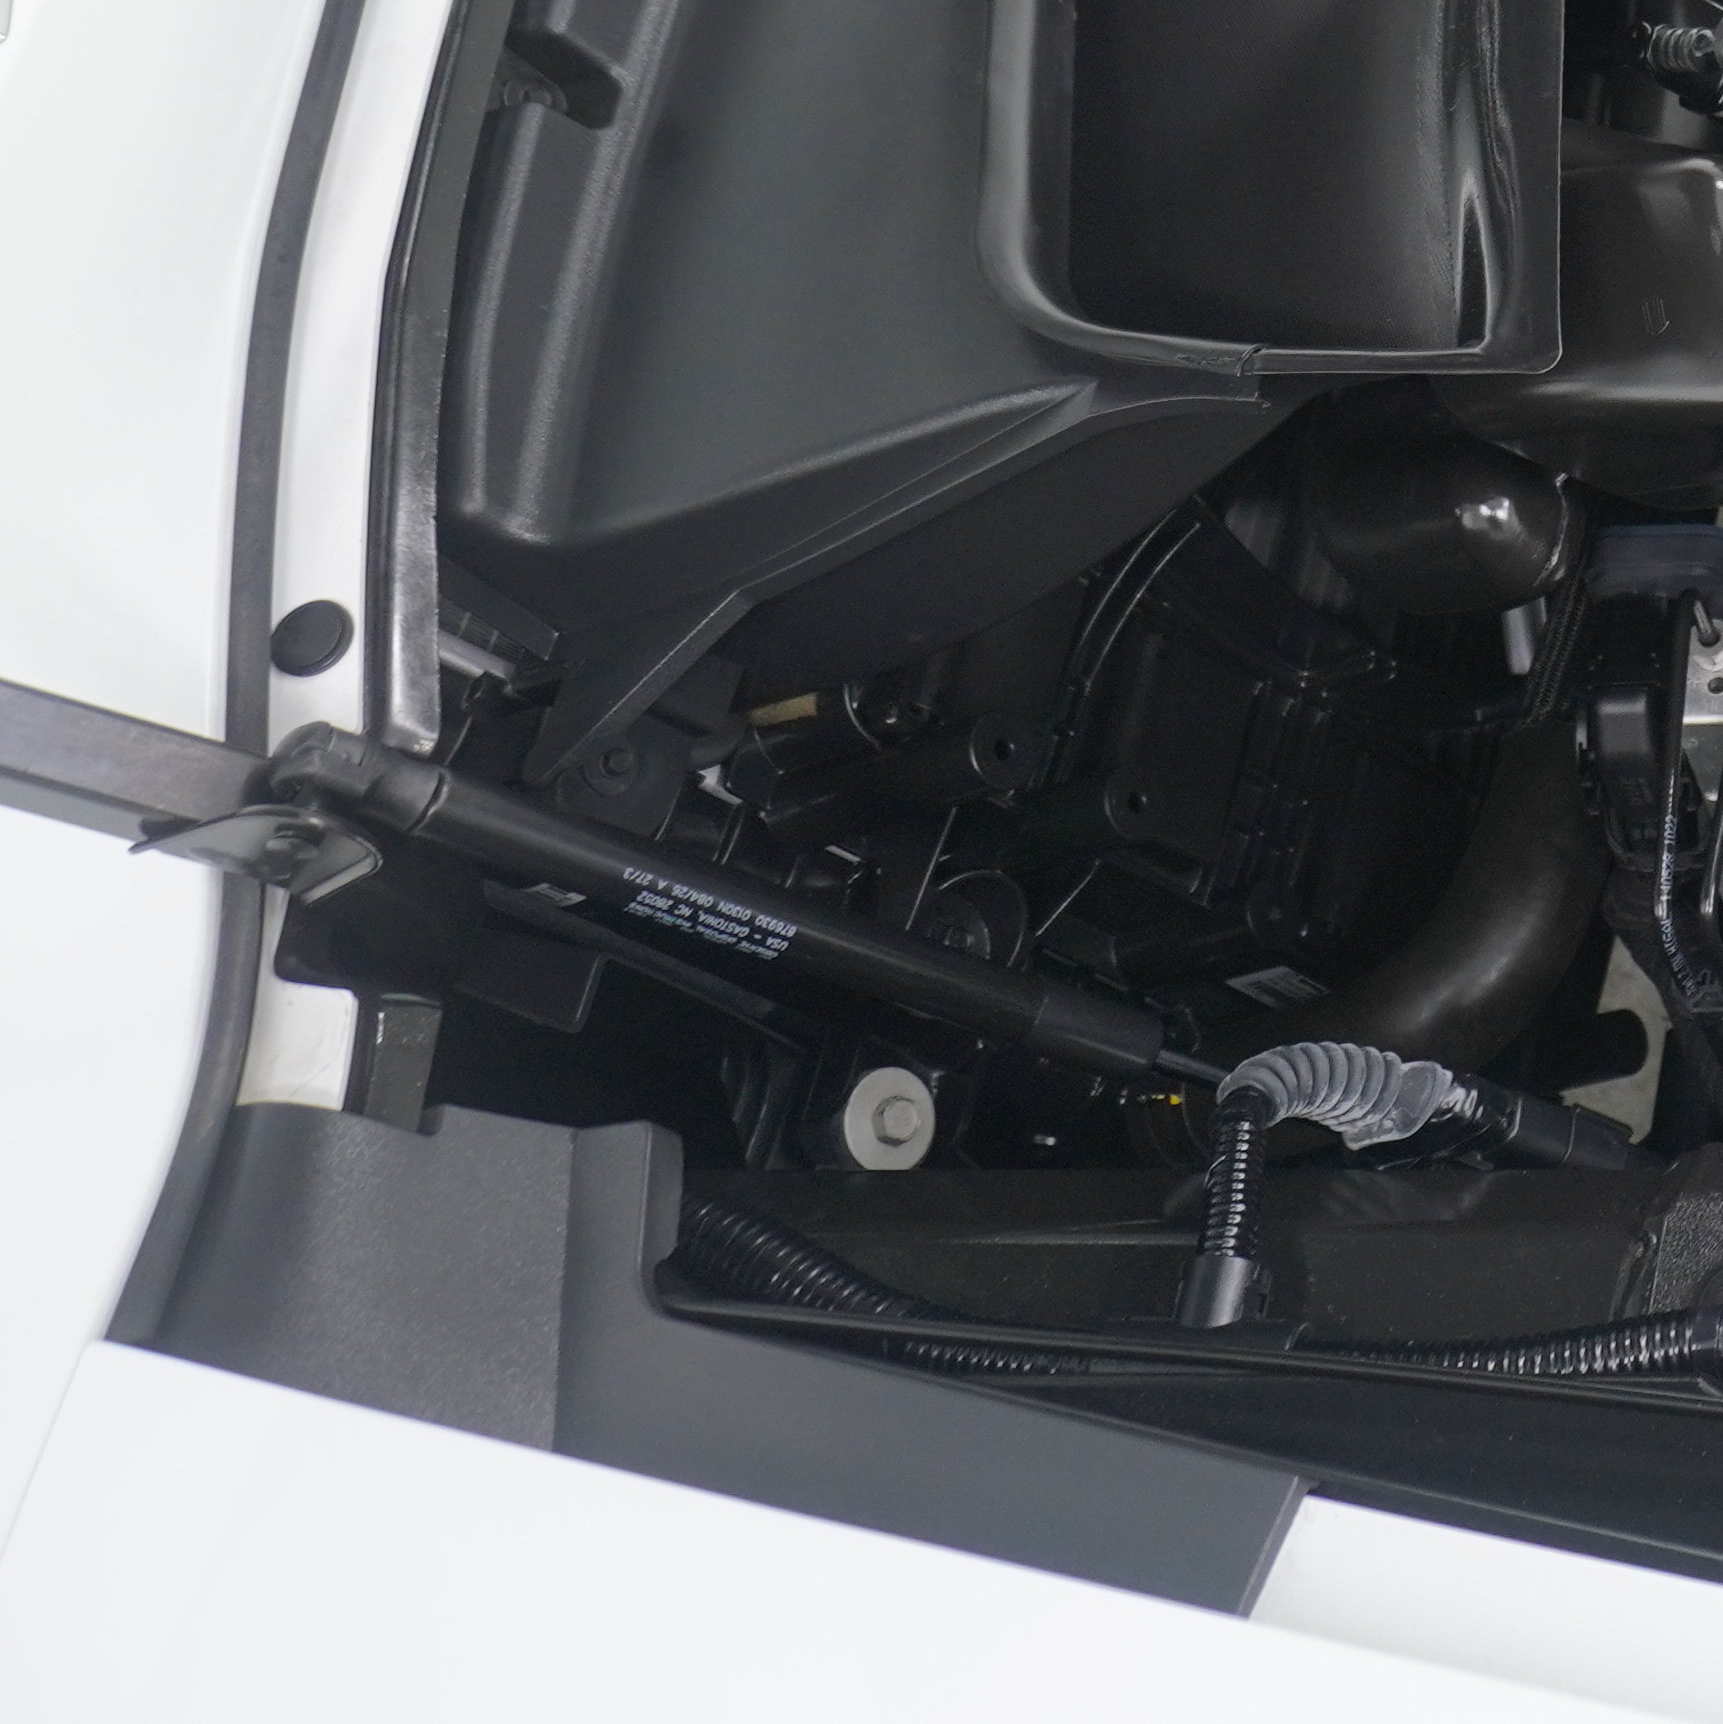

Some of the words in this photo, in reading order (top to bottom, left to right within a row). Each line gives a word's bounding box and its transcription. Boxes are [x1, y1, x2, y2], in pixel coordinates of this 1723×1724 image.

[657, 879, 669, 891] A
[636, 890, 673, 910] 28052
[676, 905, 693, 918] NC
[765, 936, 789, 951] USA
